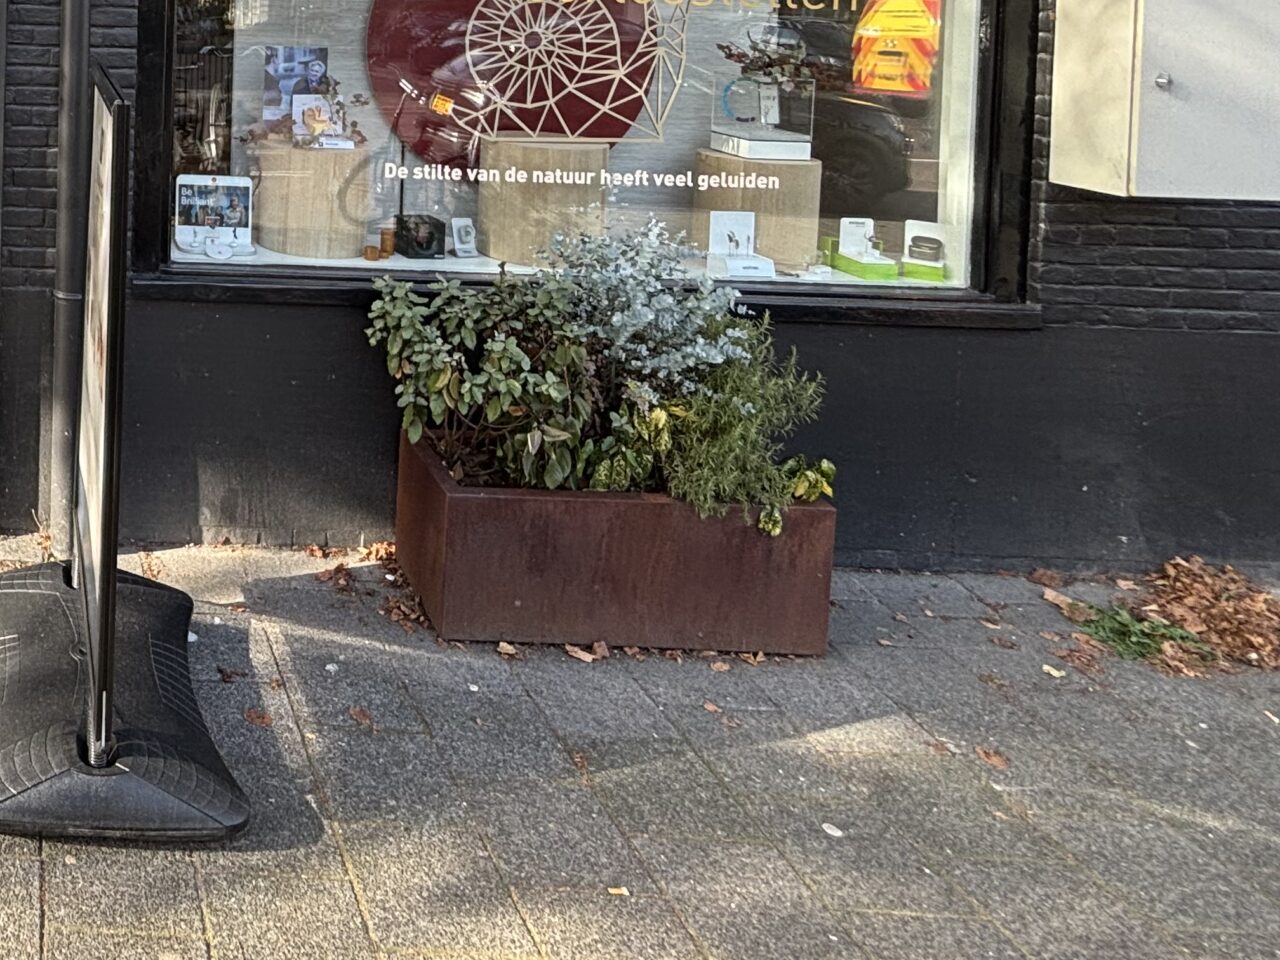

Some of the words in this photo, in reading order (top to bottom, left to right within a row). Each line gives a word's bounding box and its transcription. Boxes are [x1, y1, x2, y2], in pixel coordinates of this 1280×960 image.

[384, 162, 409, 180] De
[412, 163, 462, 181] stilte
[466, 168, 501, 183] van
[504, 166, 529, 183] de
[532, 167, 596, 185] natuur
[600, 168, 649, 187] heeft
[653, 171, 694, 188] veel
[697, 172, 780, 190] geluiden
